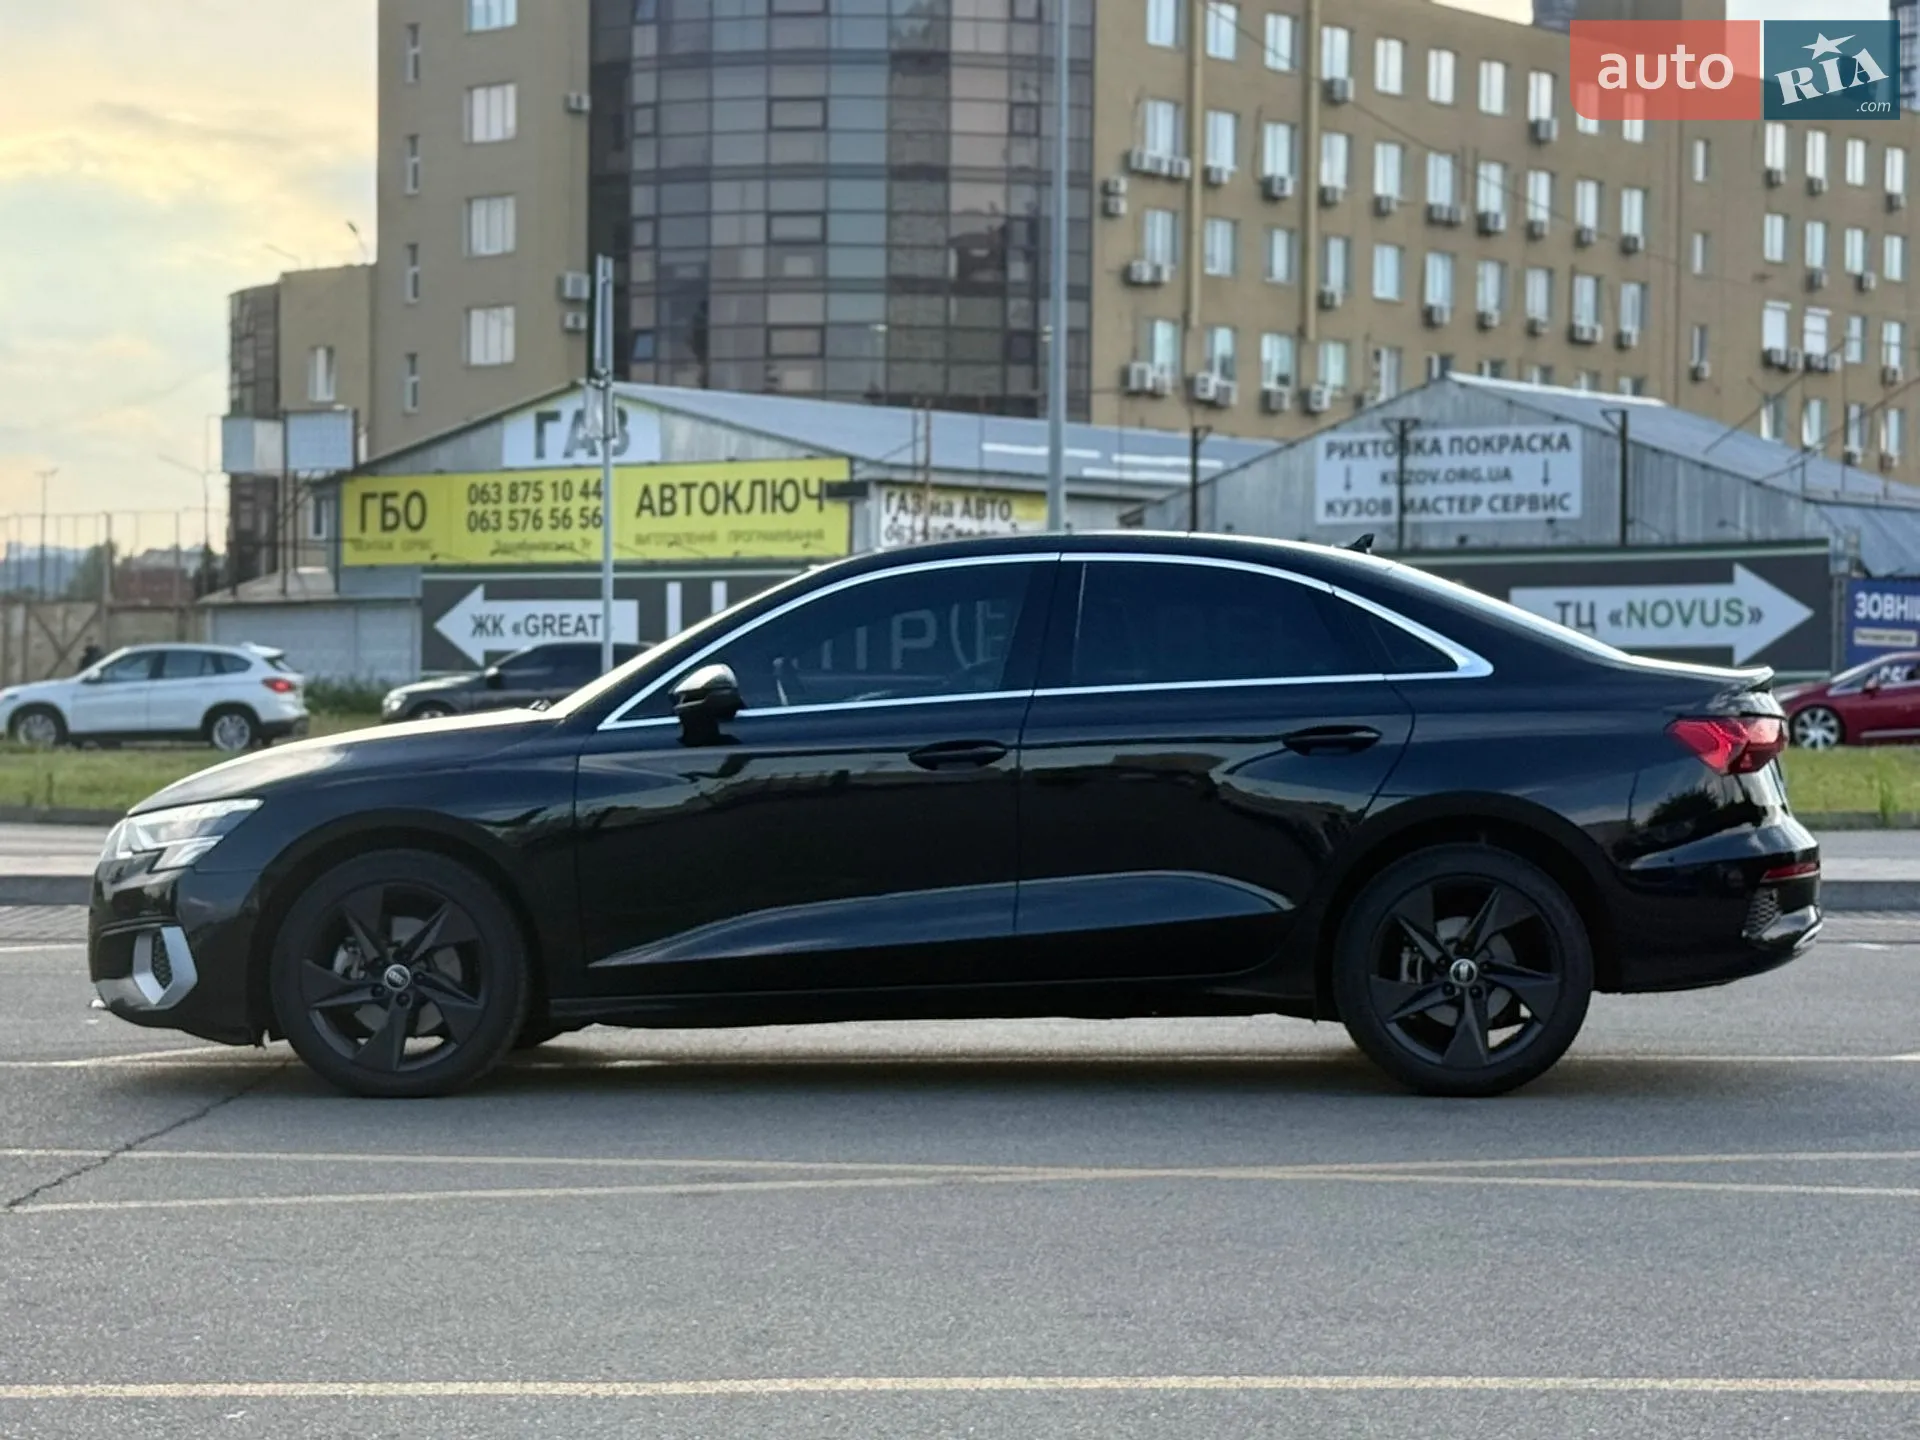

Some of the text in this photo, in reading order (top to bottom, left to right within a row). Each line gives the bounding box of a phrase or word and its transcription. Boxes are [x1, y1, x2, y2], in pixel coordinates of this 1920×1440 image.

[1451, 432, 1571, 455] ПОКРАСКА
[467, 478, 604, 506] 063 875 10 44
[635, 478, 824, 518] АВТОКЛЮЧ
[1325, 497, 1393, 517] КУЗОВ
[1488, 492, 1572, 514] СЕРВИС
[360, 489, 427, 533] ГБО
[467, 505, 604, 532] 063 576 56 56
[961, 493, 1012, 521] АВТО
[470, 613, 604, 638] ЖК «GREAT
[1554, 597, 1764, 633] ТЦ «NOVUS»
